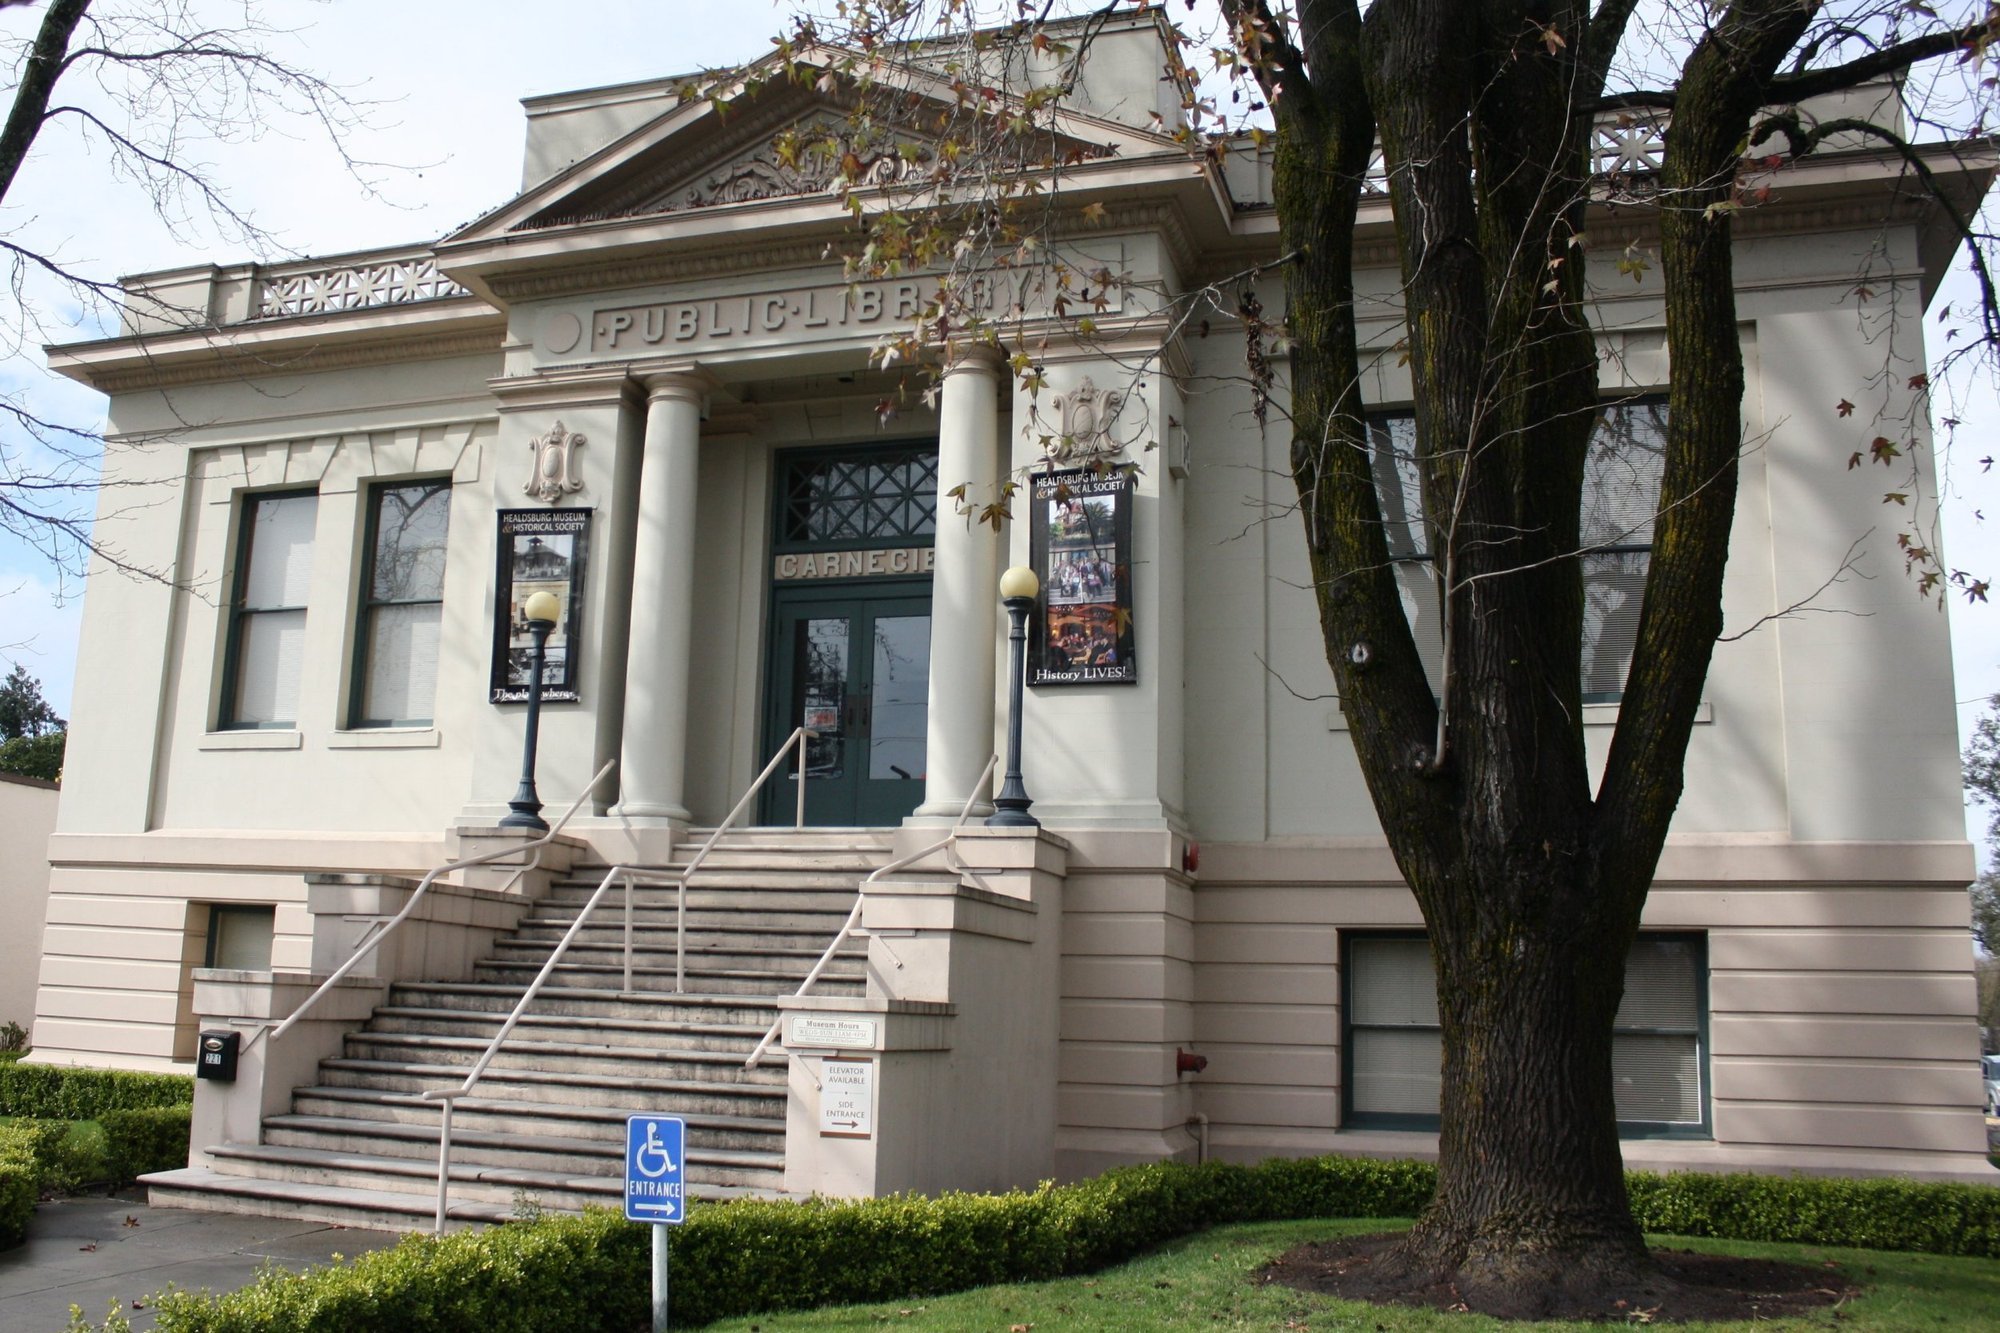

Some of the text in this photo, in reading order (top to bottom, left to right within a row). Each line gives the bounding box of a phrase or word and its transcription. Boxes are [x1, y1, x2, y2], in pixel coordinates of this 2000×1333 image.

[608, 269, 1031, 347] PUBLIC LIBRRY
[503, 512, 586, 522] HEALDSBURG MUSEUM
[512, 523, 553, 532] HISTORICAL
[554, 522, 585, 531] SOCIETY
[1035, 666, 1126, 682] History LIVES!
[806, 1020, 860, 1029] Museum Hours
[829, 1066, 865, 1075] ELEVATOR
[828, 1076, 866, 1085] AVAILABLE
[838, 1101, 854, 1109] SIDE
[826, 1110, 865, 1119] ENTRANCE
[629, 1180, 680, 1197] ENTRANCE
